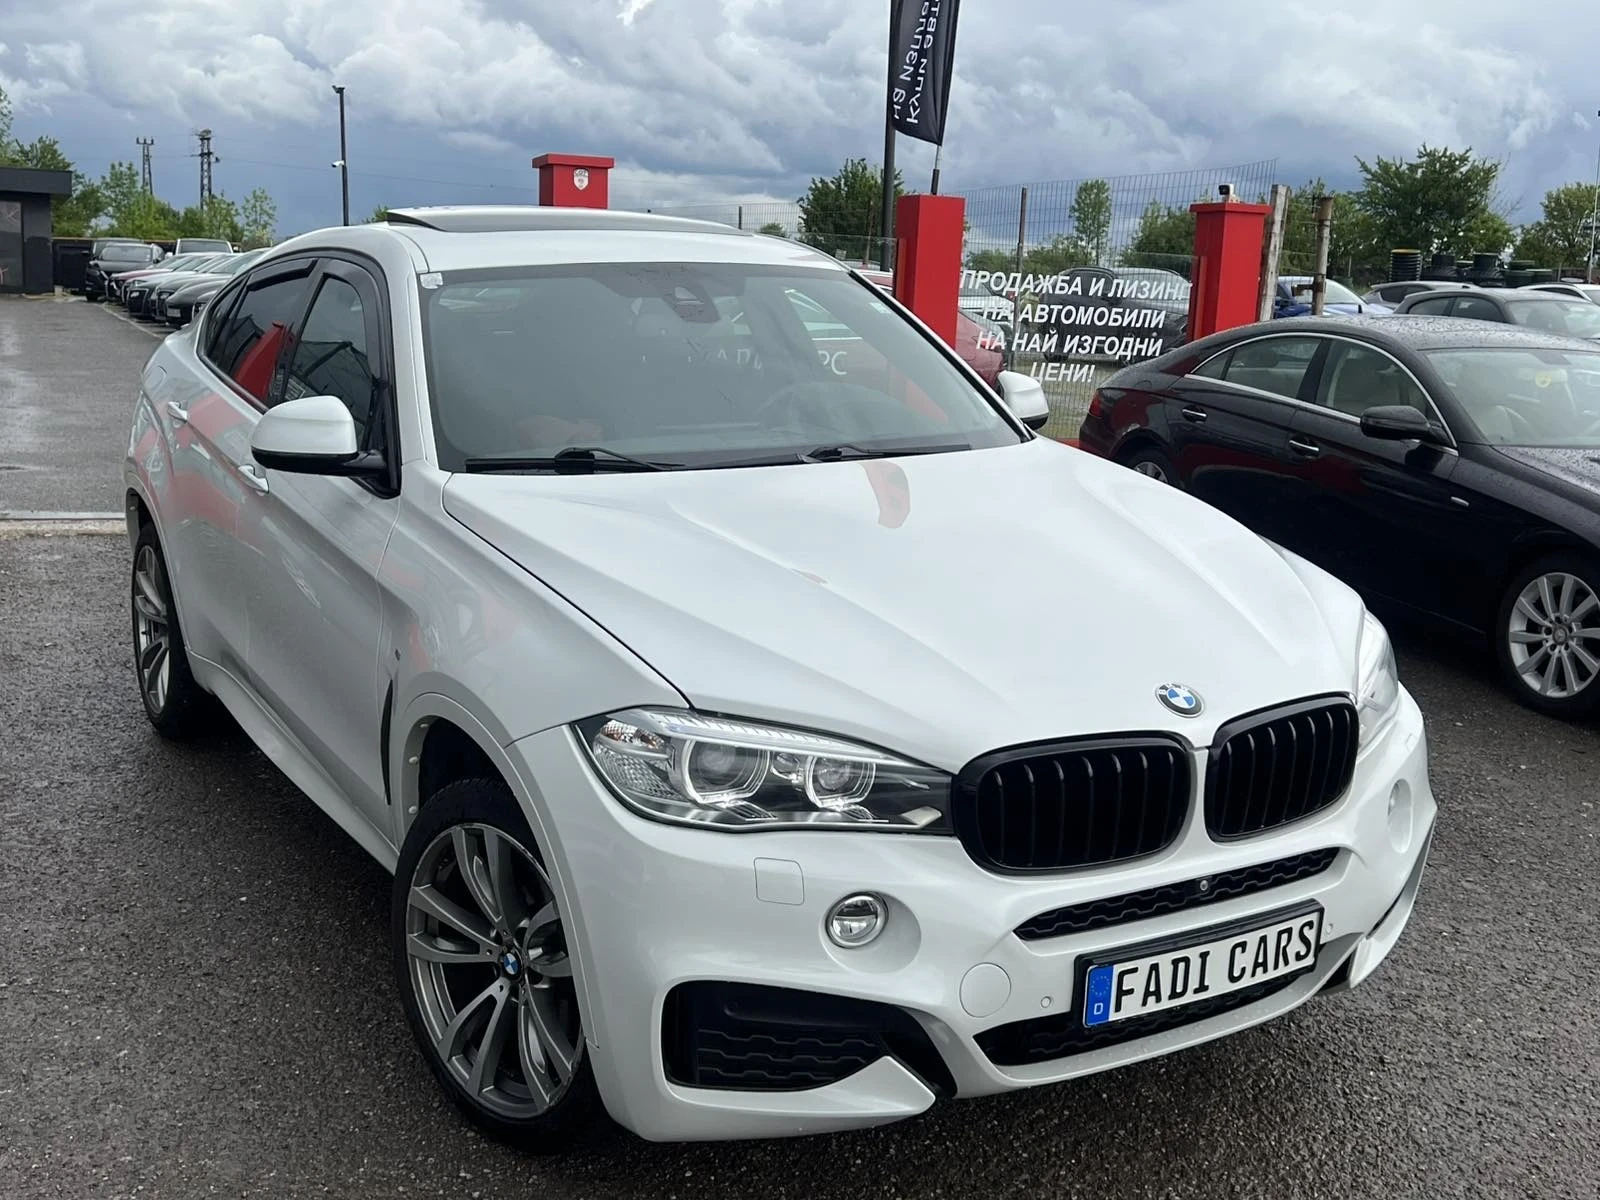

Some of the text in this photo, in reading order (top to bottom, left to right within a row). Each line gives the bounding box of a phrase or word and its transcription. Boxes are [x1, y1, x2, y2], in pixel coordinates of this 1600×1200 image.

[959, 269, 1083, 297] ПРОДАЖБА
[1088, 277, 1105, 297] И
[1018, 303, 1167, 329] АВТОМОБИЛИ
[976, 327, 1164, 360] НА НАЙ ИЗГОДНИ
[1030, 362, 1096, 383] ЦЕНИ!
[1114, 920, 1314, 1013] FADI CARS
[1093, 1002, 1104, 1016] D
